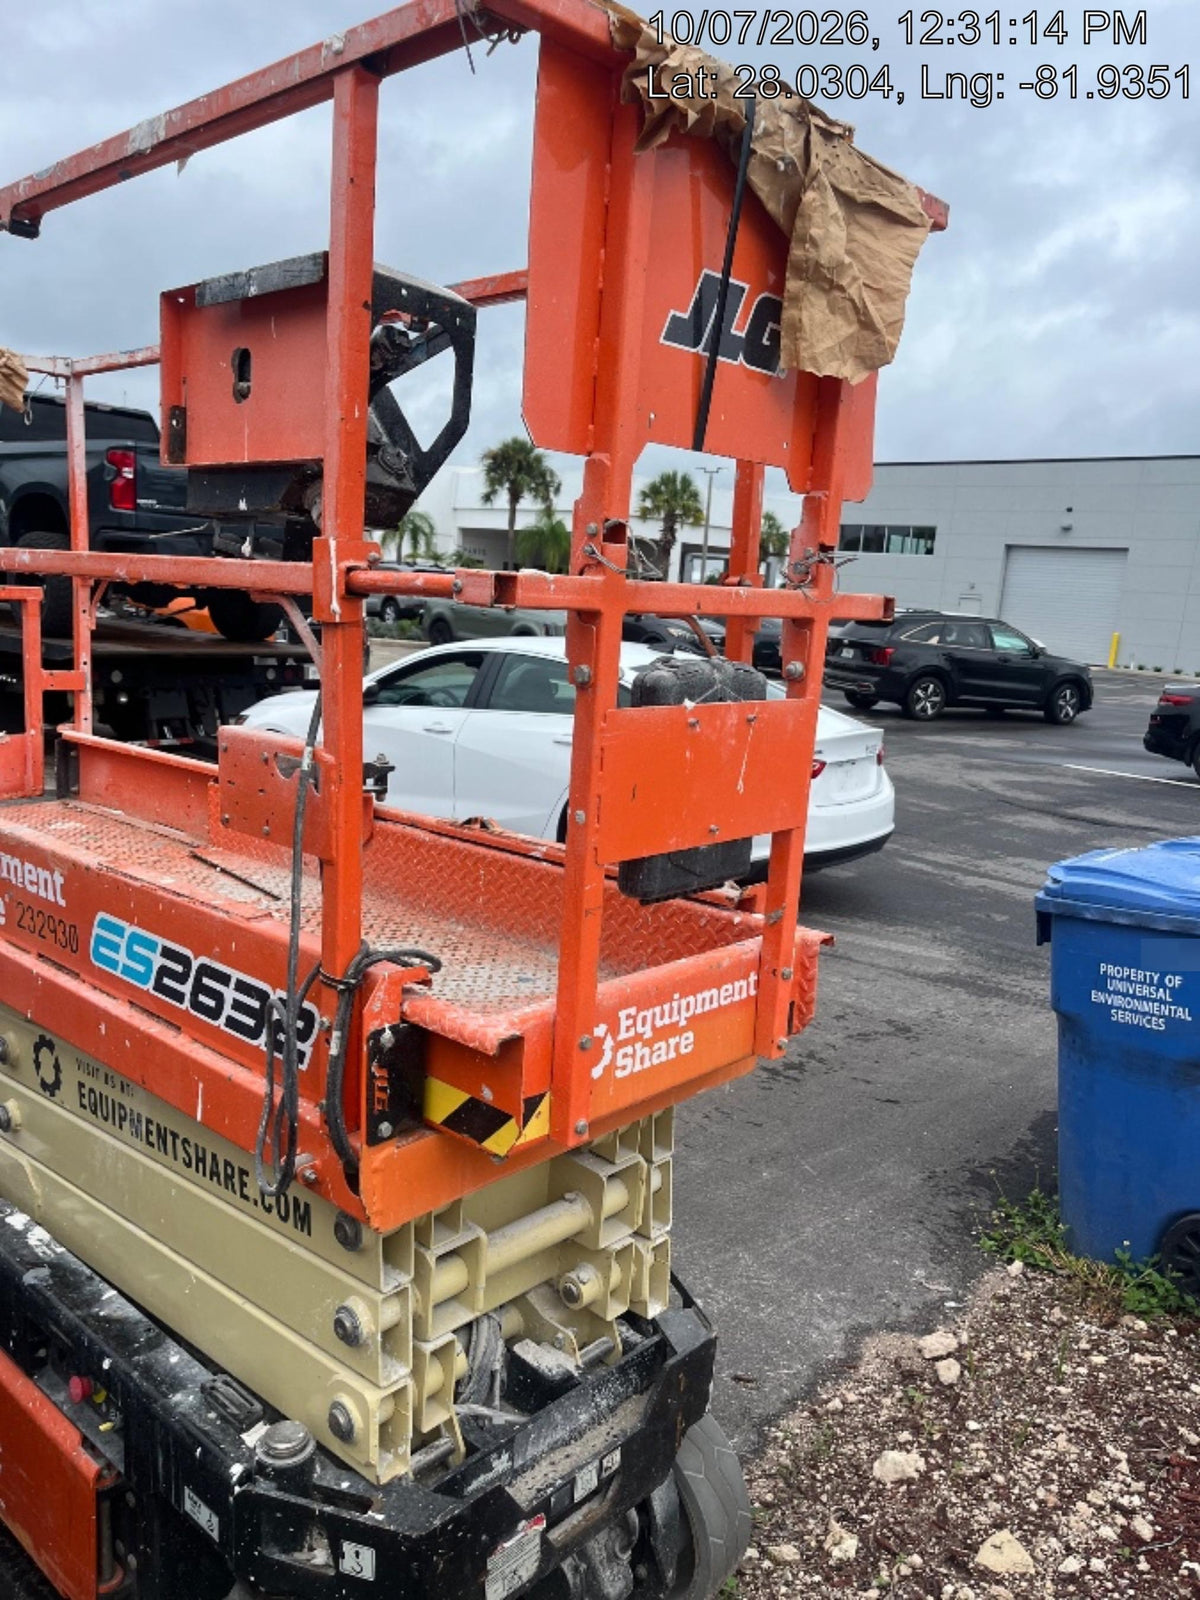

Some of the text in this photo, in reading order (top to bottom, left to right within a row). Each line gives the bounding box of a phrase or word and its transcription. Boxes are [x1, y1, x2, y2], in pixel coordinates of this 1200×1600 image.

[659, 268, 784, 377] JLG
[16, 901, 79, 954] 232930
[1099, 963, 1184, 989] PROPERTY OF
[1107, 978, 1173, 1002] UNIVERSAL
[617, 971, 758, 1041] Equipment
[1091, 989, 1193, 1022] ENVIRONMENTAL
[1110, 1009, 1166, 1031] SERVICES
[75, 1057, 100, 1080] VISIT
[614, 1030, 694, 1079] Share
[77, 1080, 313, 1238] EQUIPMENTSHARE.COM
